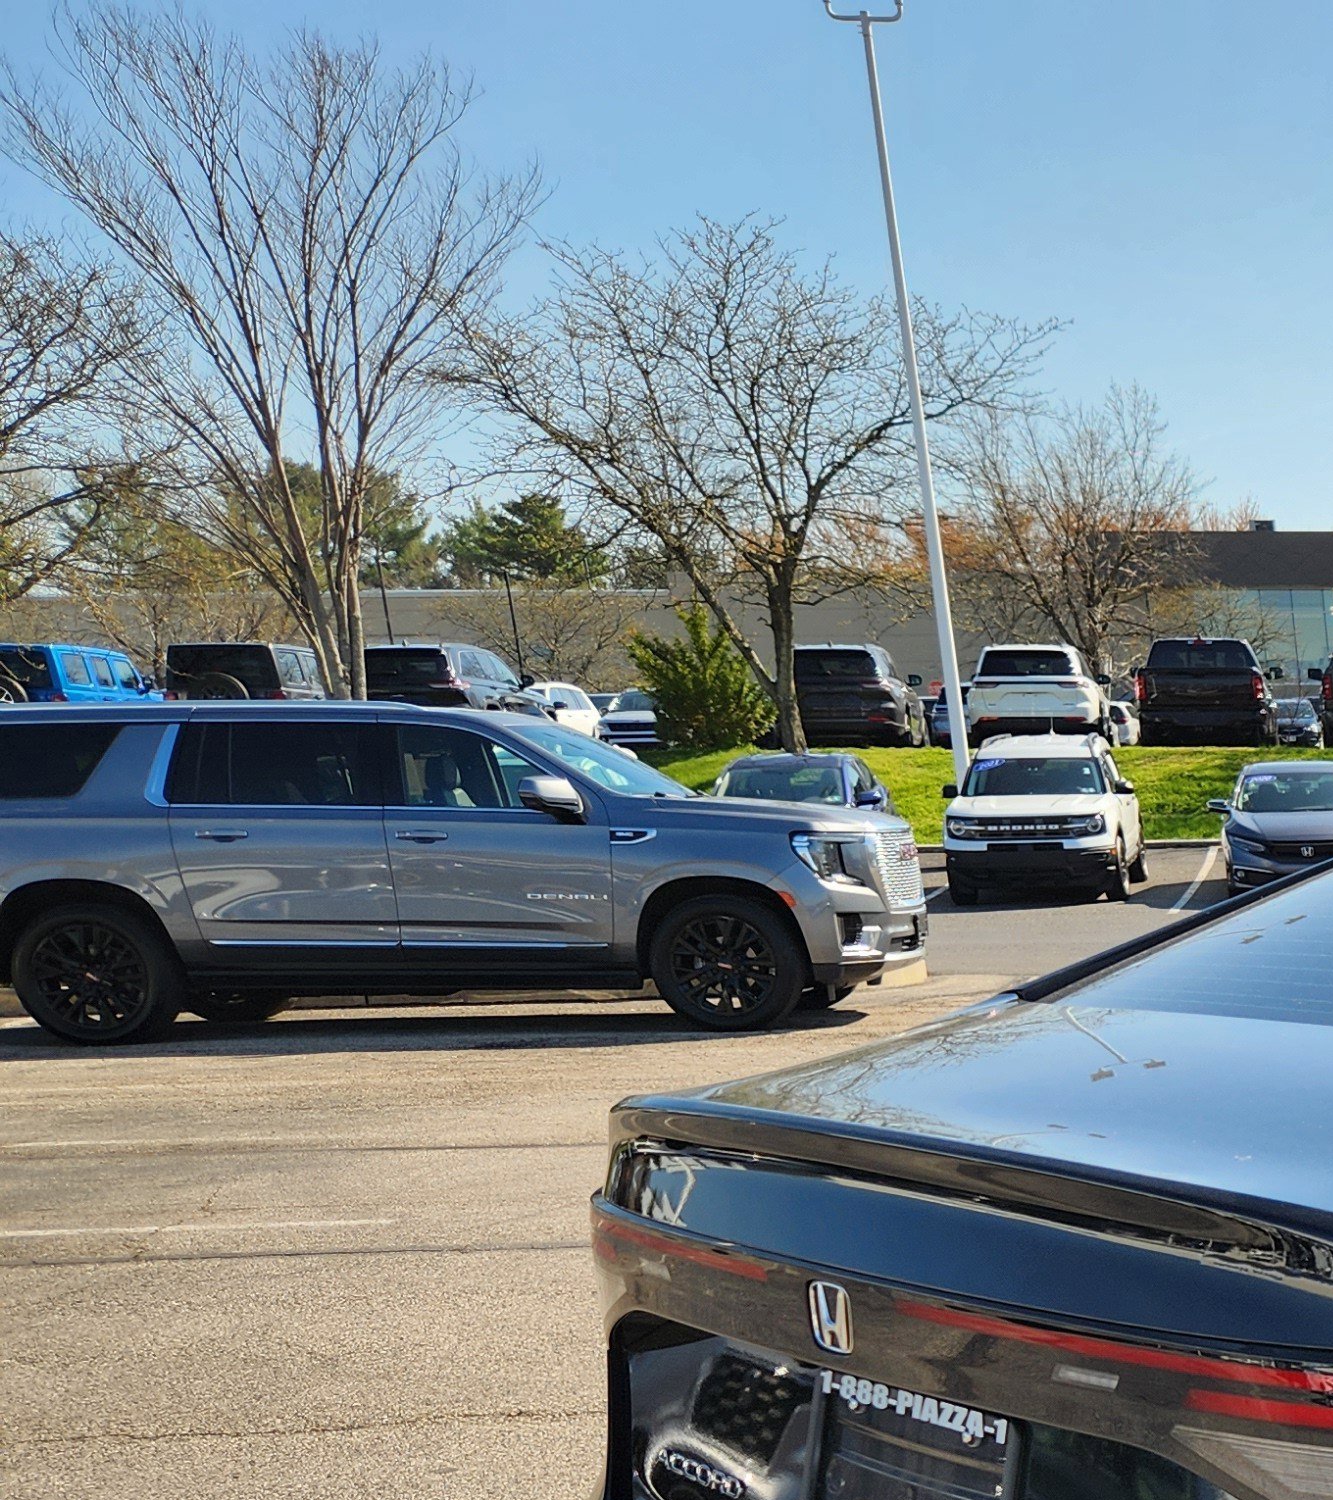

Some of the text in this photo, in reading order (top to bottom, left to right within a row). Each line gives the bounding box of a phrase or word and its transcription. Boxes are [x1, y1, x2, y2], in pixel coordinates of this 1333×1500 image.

[526, 892, 609, 900] DENALI
[820, 1370, 1008, 1445] 1-888-PIAZZA-1
[655, 1448, 743, 1500] ACCORD
